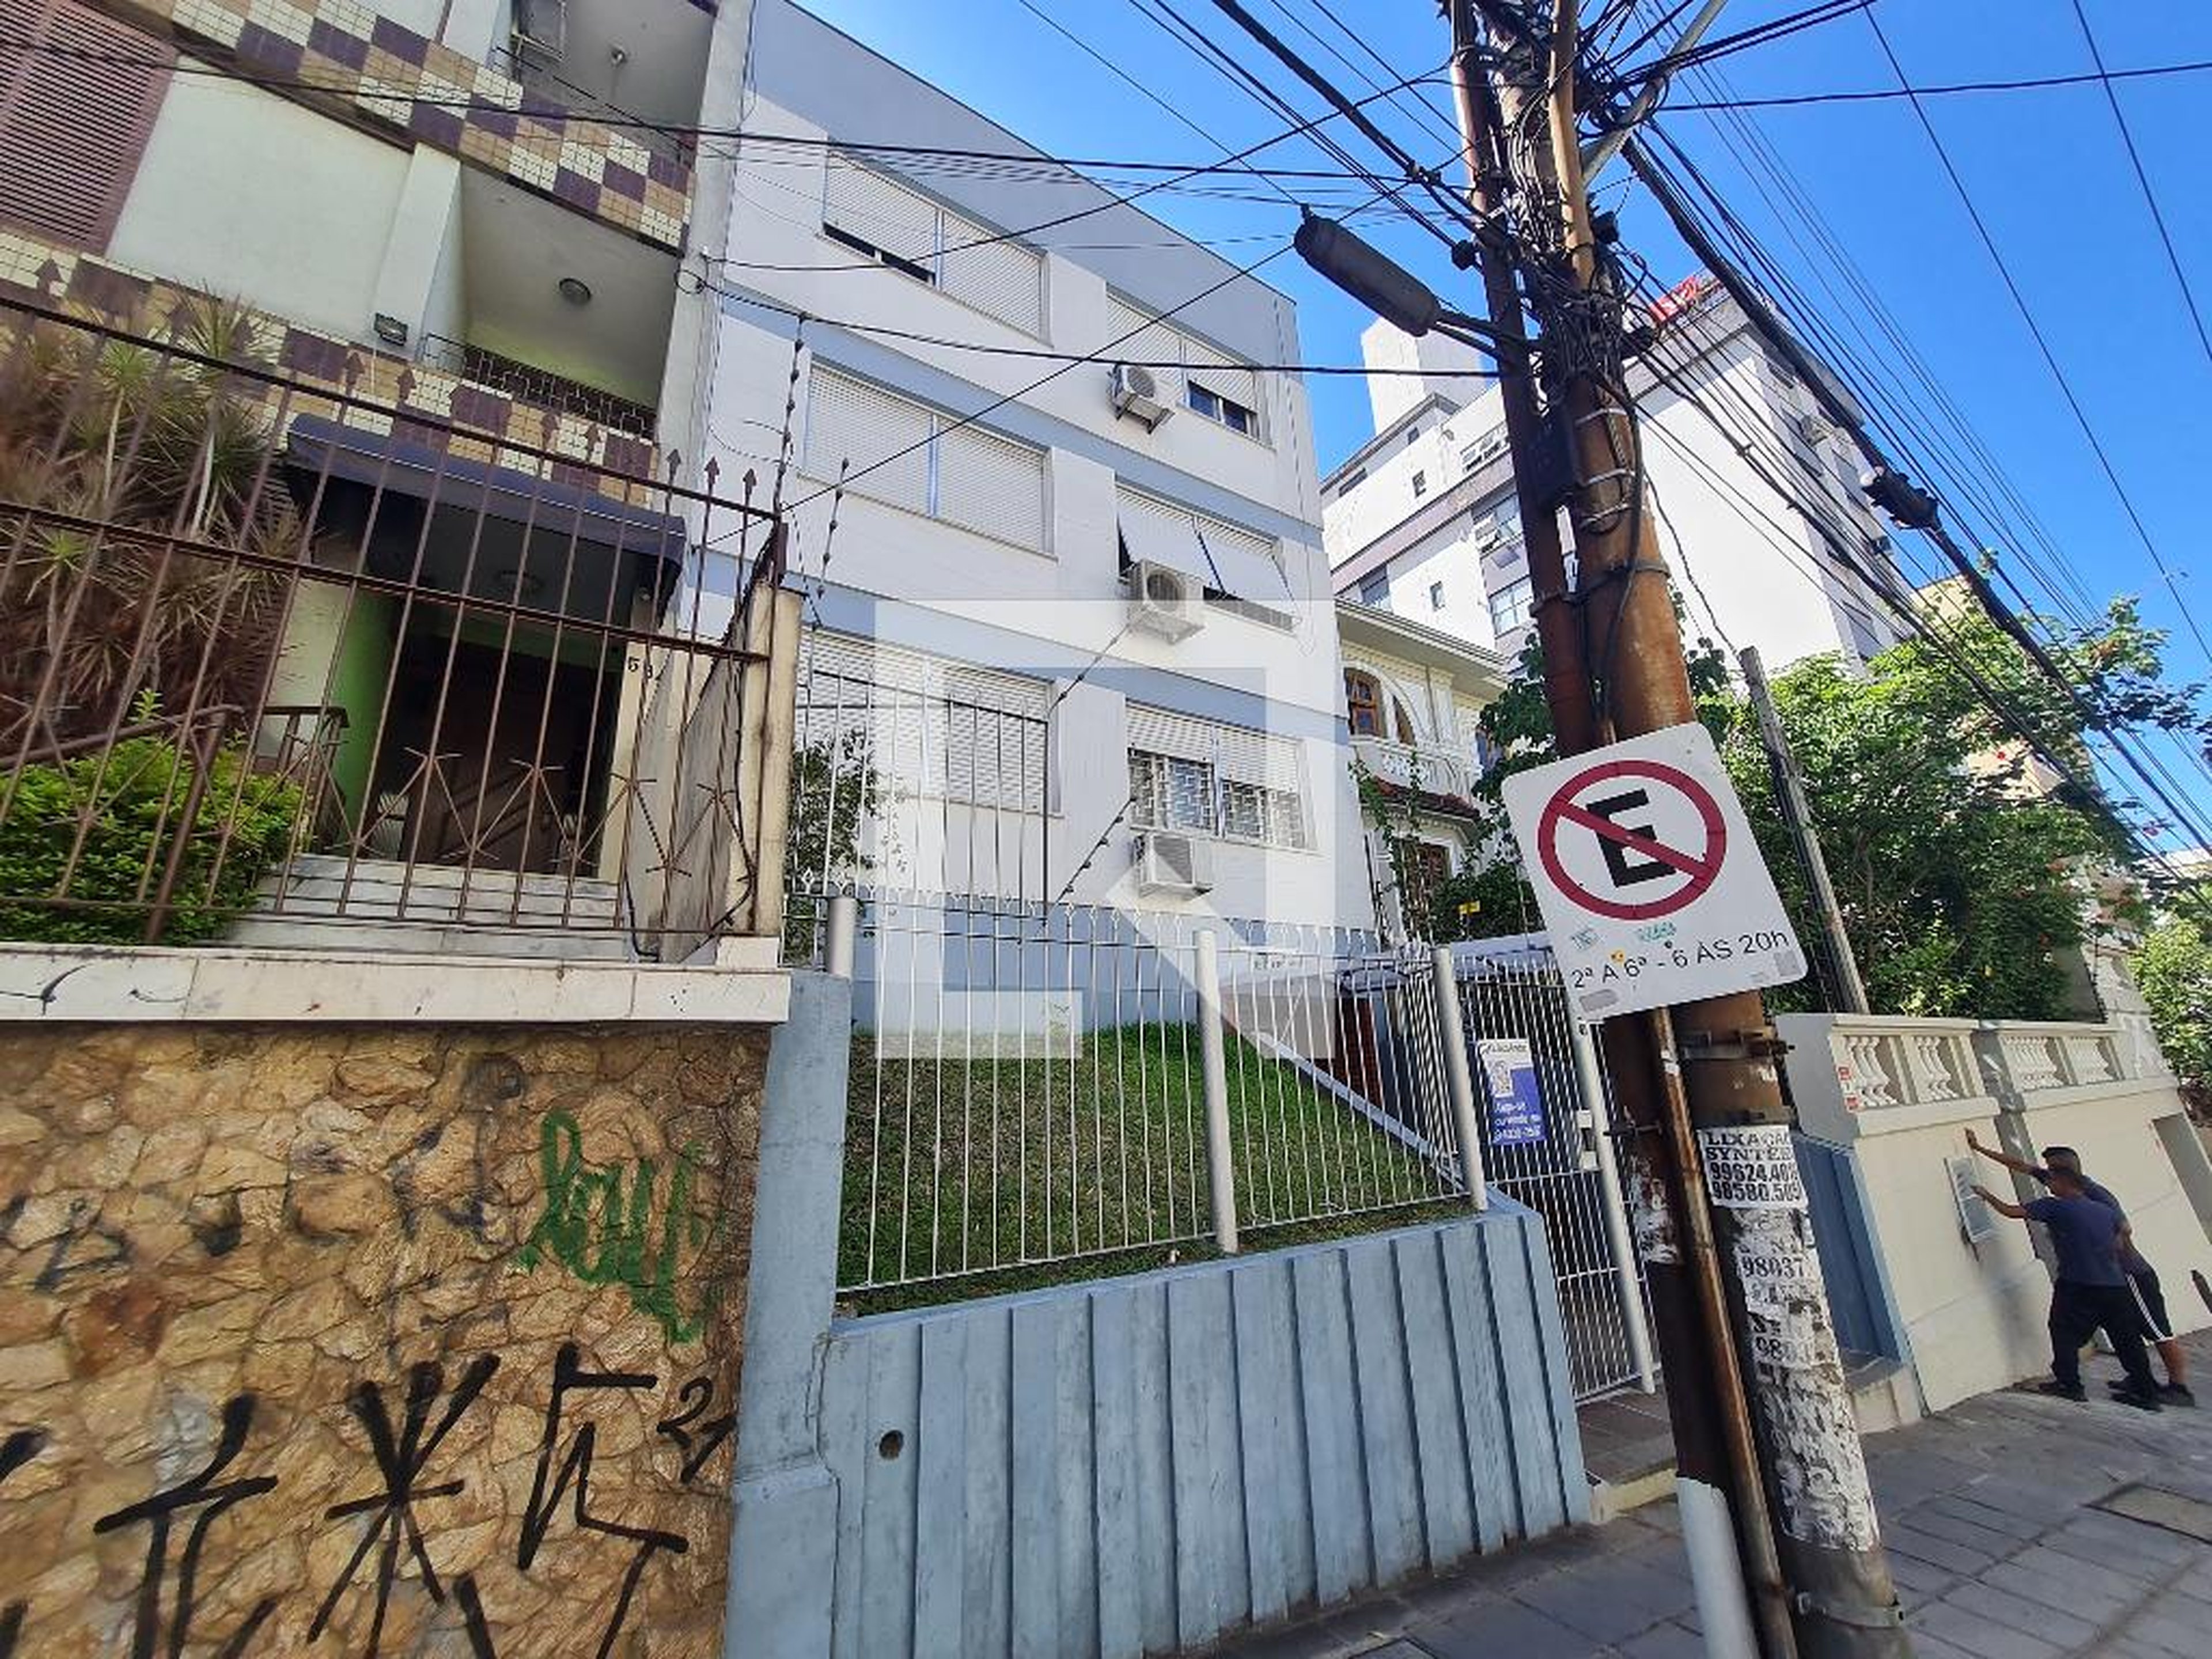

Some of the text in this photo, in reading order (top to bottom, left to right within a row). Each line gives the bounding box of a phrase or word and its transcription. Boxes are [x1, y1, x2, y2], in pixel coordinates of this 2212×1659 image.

[1587, 789, 1676, 888] E
[1672, 950, 1688, 968] 6
[1738, 930, 1789, 954] 20h
